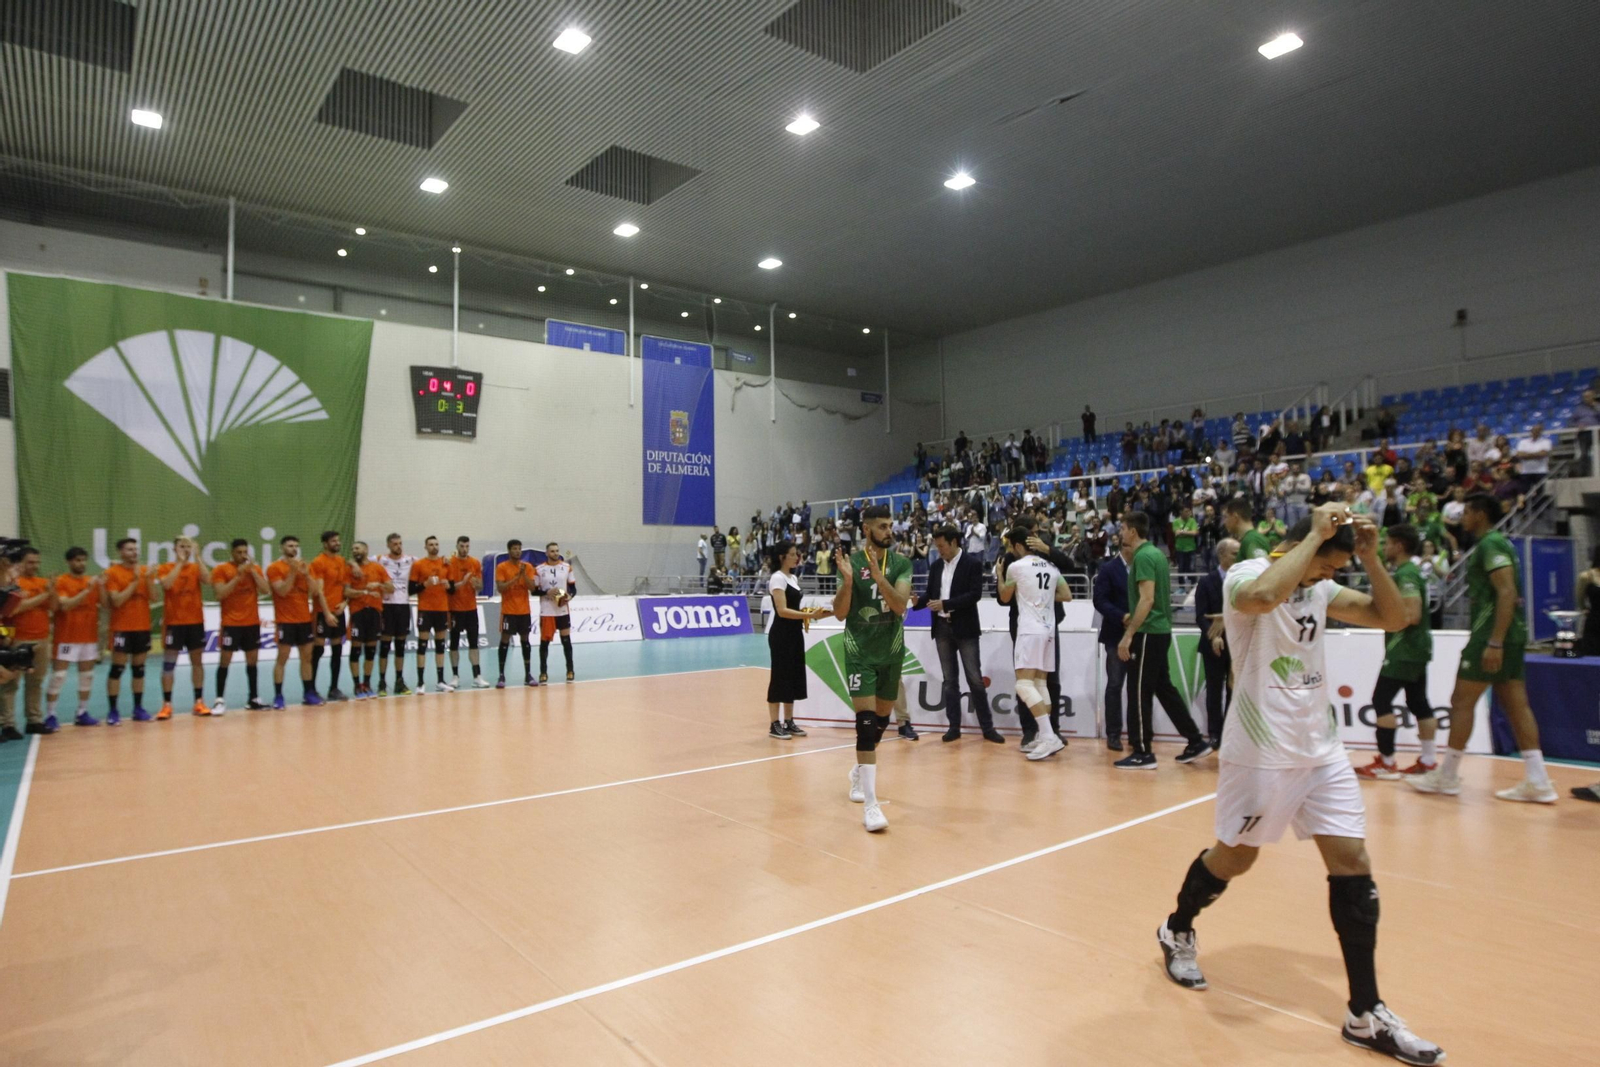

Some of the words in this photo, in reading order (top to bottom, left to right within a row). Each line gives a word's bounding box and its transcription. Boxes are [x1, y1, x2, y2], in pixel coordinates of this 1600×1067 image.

[443, 381, 452, 392] 4
[646, 450, 712, 464] DIPUTACIÓN
[648, 463, 662, 473] DE
[664, 464, 710, 476] ALMERÍA
[550, 568, 556, 577] 4
[1036, 572, 1050, 590] 12
[590, 613, 638, 634] Pino
[849, 673, 862, 688] 15
